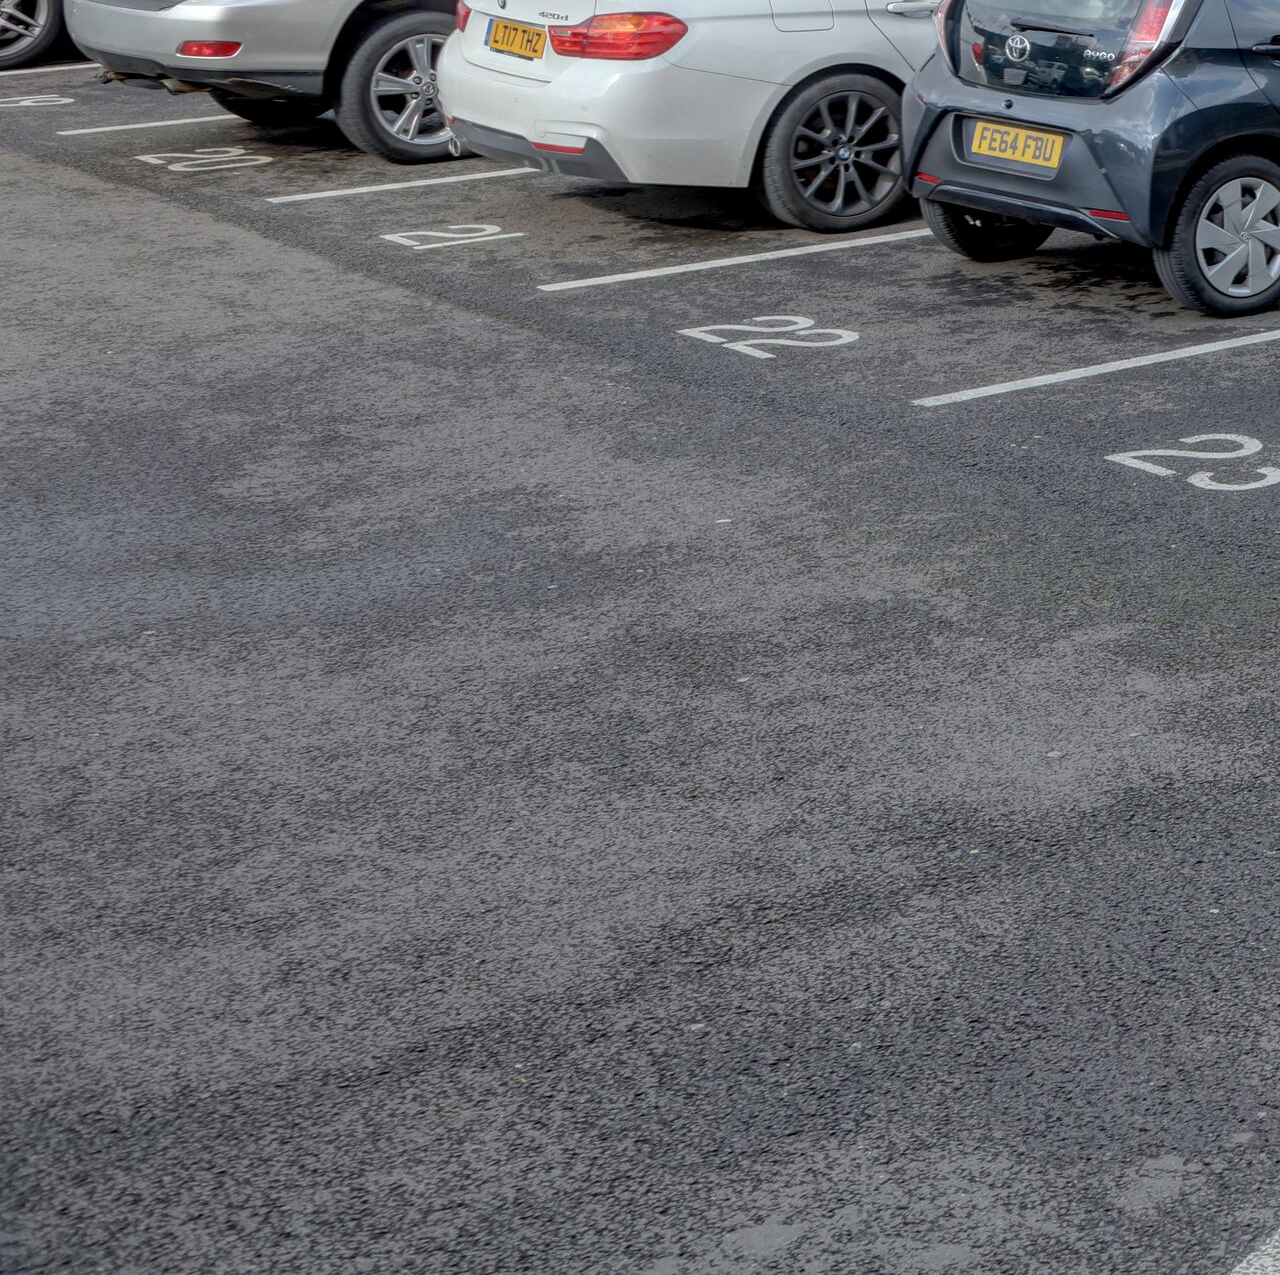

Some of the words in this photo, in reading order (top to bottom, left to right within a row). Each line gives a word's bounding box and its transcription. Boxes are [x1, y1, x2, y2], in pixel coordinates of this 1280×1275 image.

[538, 11, 569, 21] 420d
[493, 23, 519, 47] LT17
[519, 29, 542, 53] THZ
[978, 126, 1019, 155] FE64
[1022, 135, 1056, 162] FBU
[134, 147, 273, 172] 20
[379, 224, 528, 250] 21
[676, 315, 860, 359] 22
